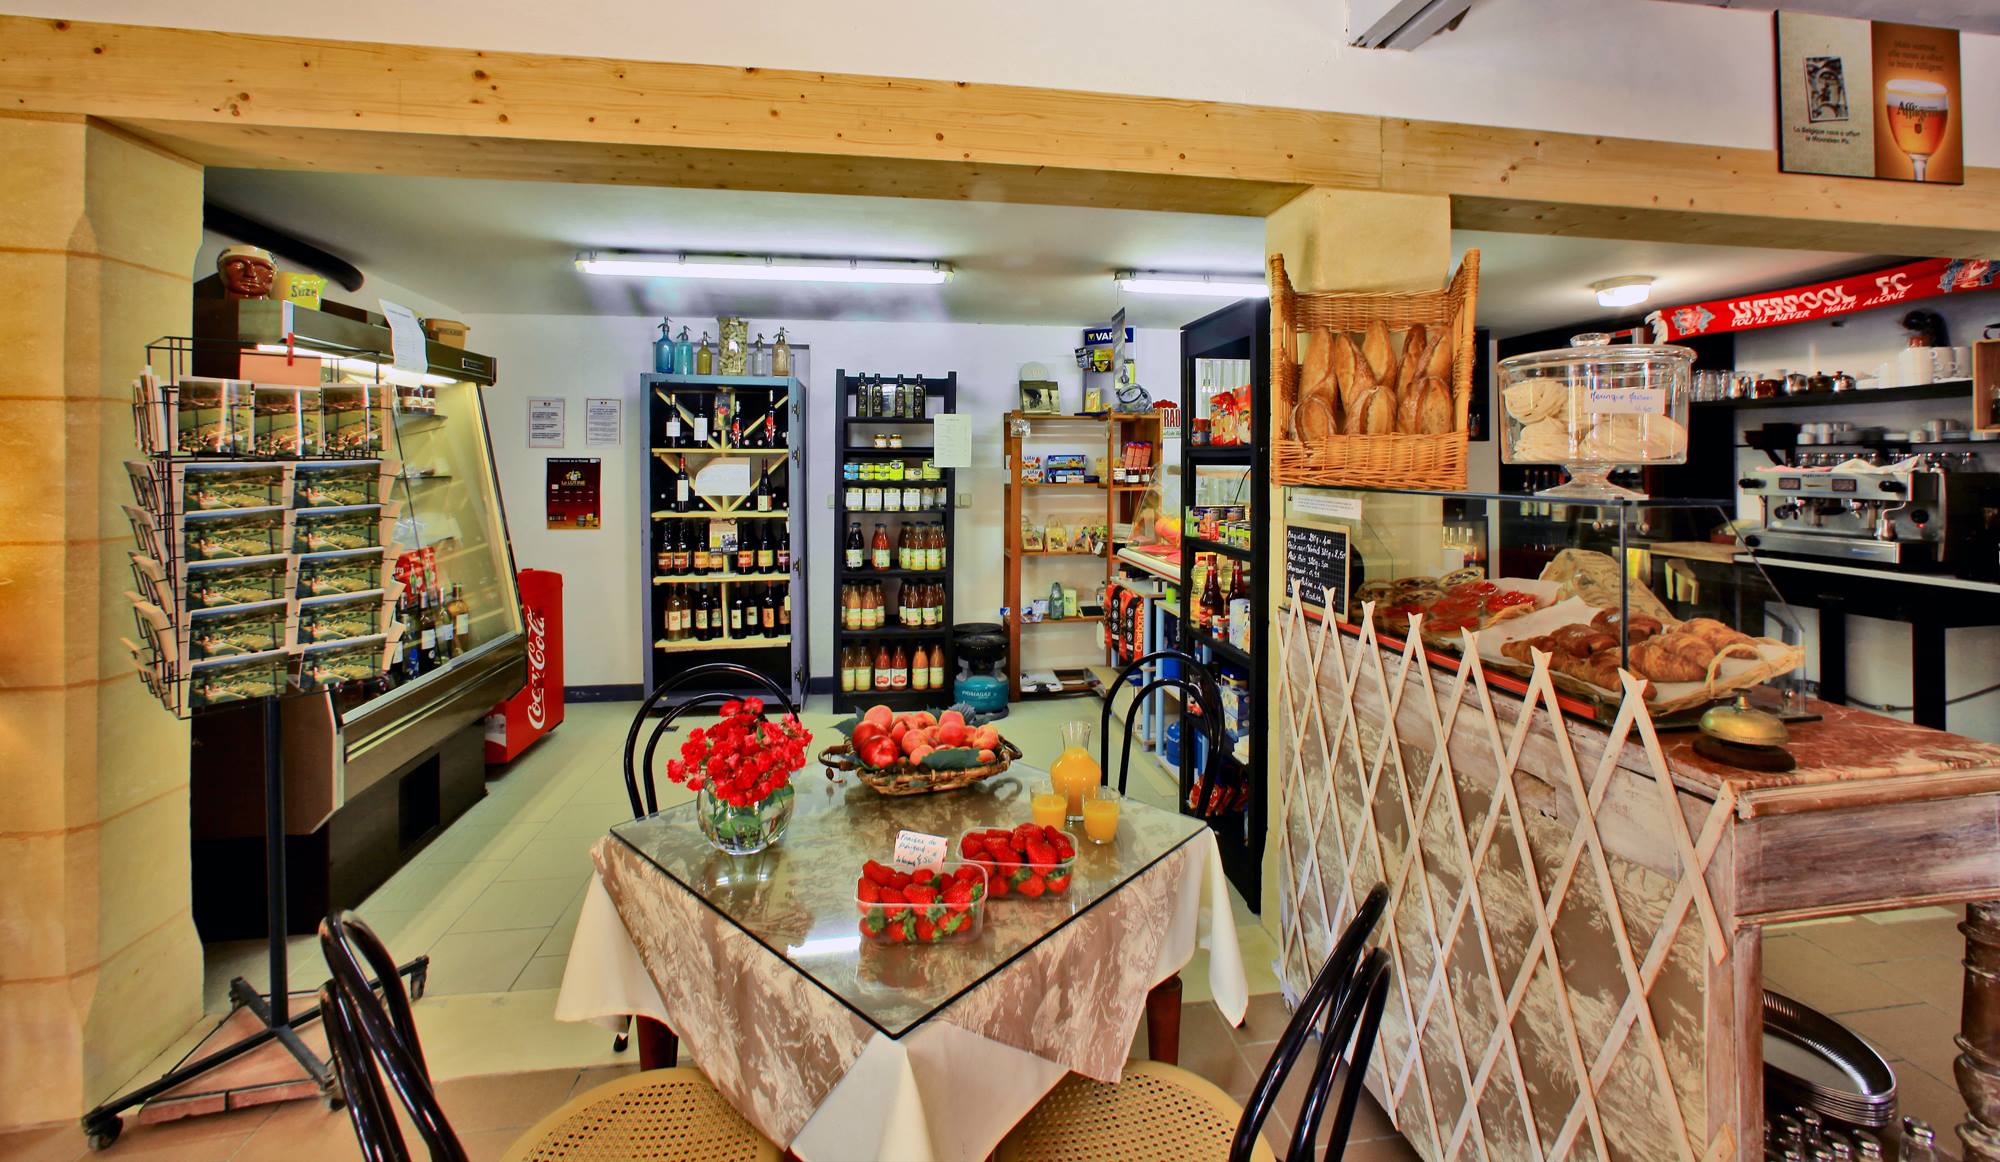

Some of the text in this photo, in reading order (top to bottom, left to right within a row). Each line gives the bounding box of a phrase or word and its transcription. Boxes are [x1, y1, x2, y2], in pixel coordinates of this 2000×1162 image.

[291, 285, 317, 298] Suze
[1728, 272, 1913, 320] LIVERPOOL FC
[1730, 291, 1906, 328] YOU'LL NEVER WALK ALONE
[1134, 616, 1144, 652] Charbon
[527, 605, 545, 729] Coca-Cola
